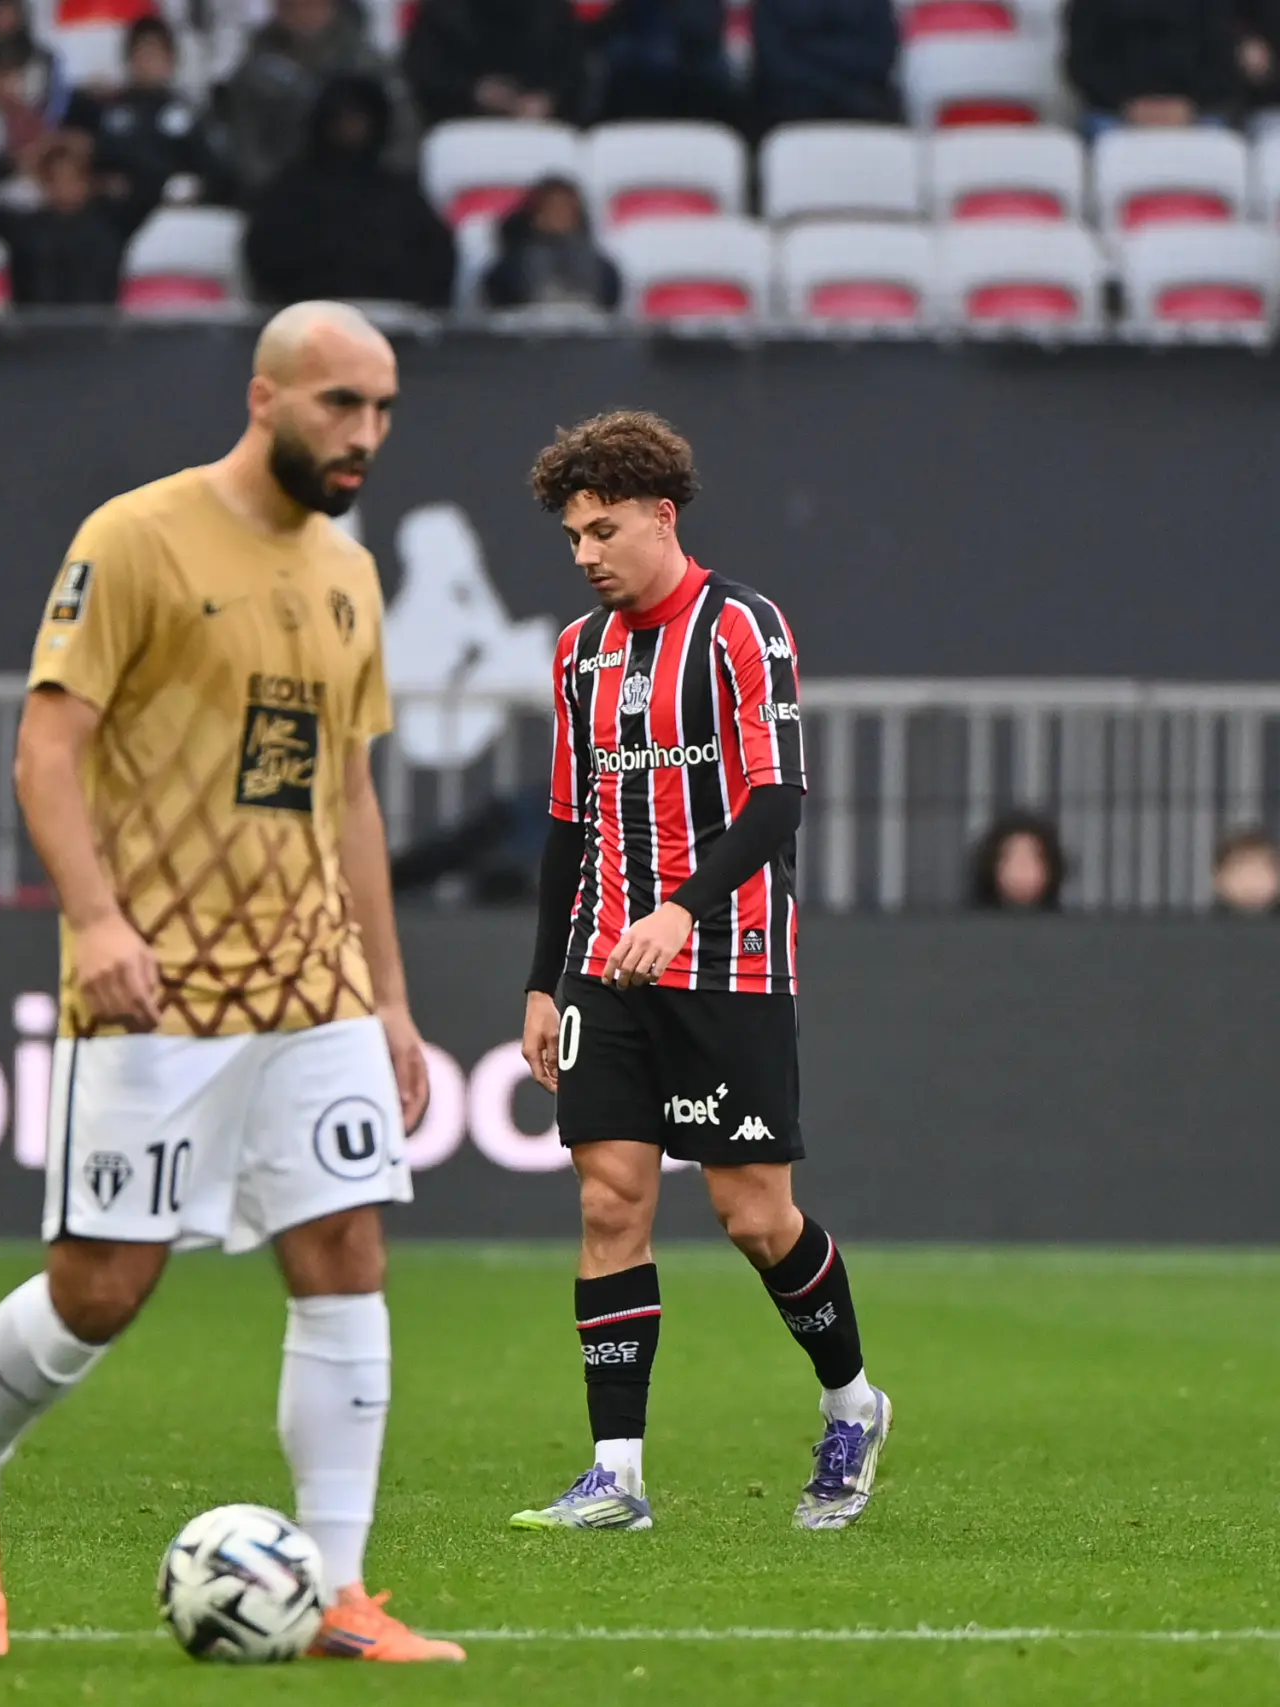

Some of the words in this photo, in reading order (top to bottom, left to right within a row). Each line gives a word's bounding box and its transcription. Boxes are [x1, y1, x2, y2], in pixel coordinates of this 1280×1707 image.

[578, 648, 624, 674] actual
[594, 736, 720, 774] Robinhood
[743, 941, 763, 951] XXV
[558, 1005, 581, 1071] 0
[335, 1120, 376, 1162] U
[584, 1351, 638, 1365] NICE
